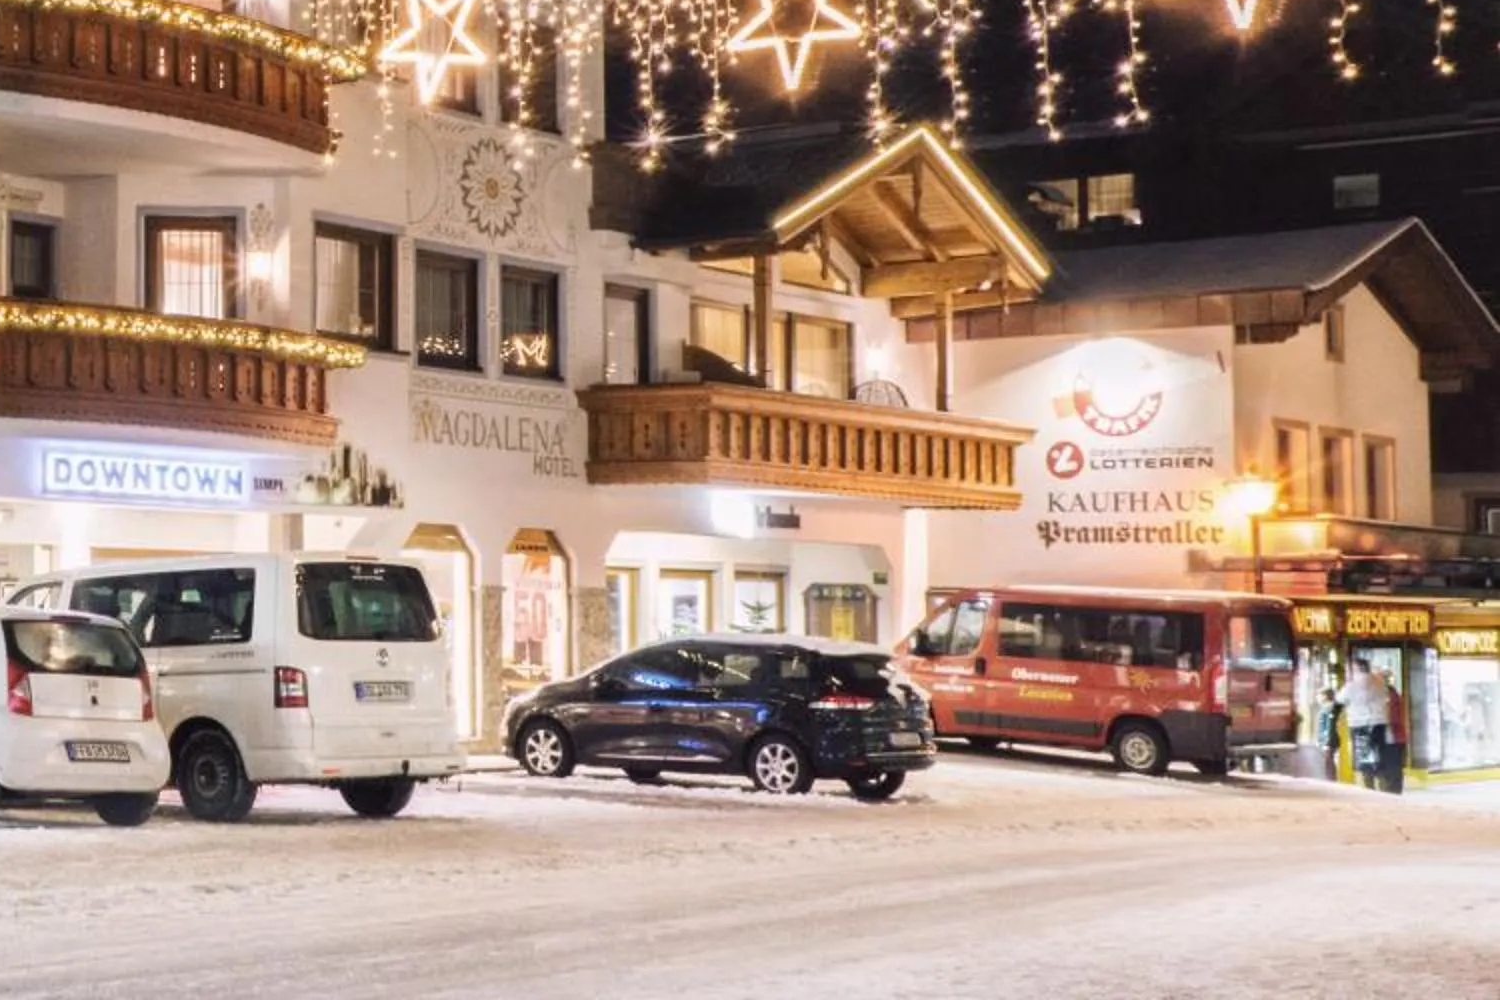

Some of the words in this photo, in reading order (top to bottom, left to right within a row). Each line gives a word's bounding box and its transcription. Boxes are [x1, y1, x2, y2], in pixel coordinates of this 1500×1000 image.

[414, 402, 565, 455] MAGDALENA
[52, 457, 243, 495] DOWNTOWN
[533, 455, 578, 477] HOTEL
[1089, 456, 1214, 471] LOTTERIEN
[1047, 490, 1214, 514] KAUFHAUS
[1036, 520, 1224, 548] Pramstraller
